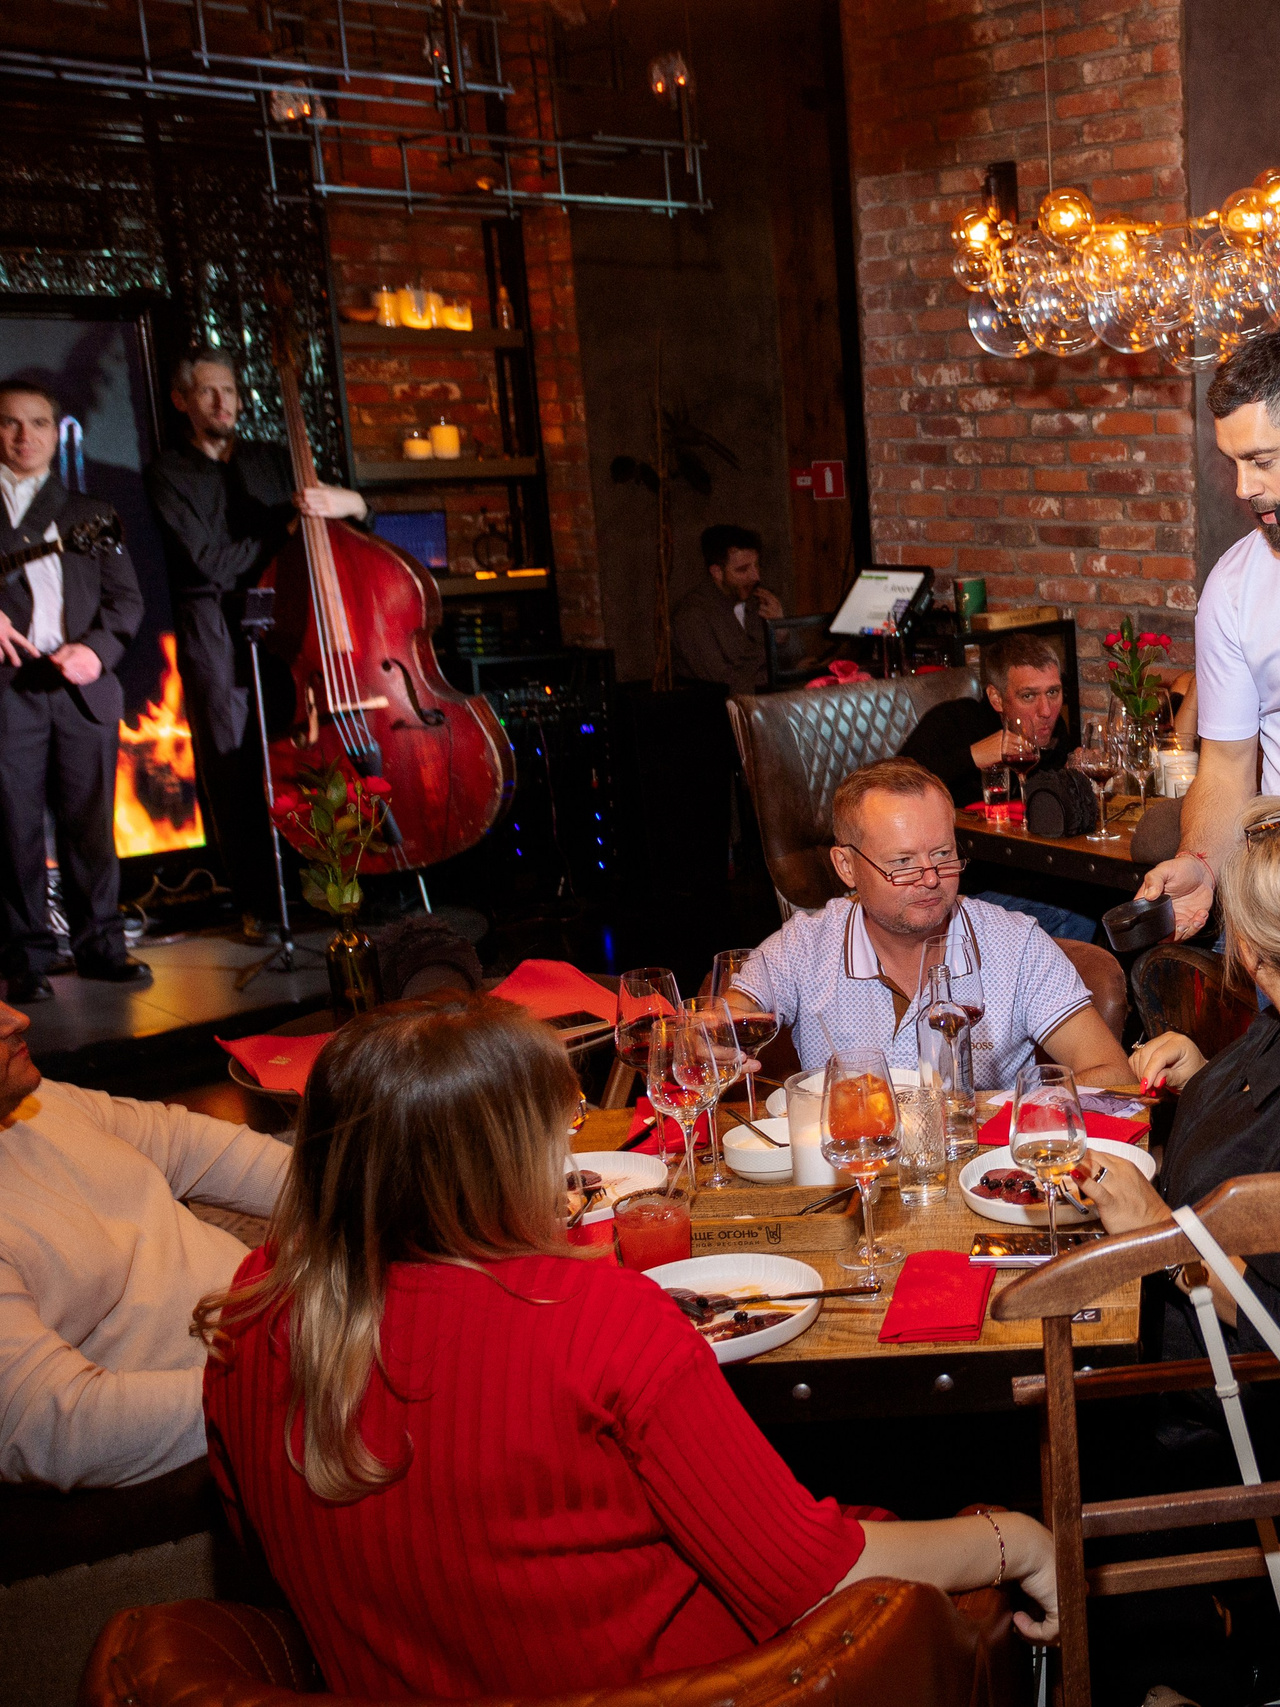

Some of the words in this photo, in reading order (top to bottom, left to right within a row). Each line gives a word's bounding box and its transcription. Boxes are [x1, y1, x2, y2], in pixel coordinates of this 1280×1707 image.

[971, 1041, 994, 1050] BOSS
[717, 1230, 759, 1239] ОГОНЬ
[1072, 1310, 1096, 1321] 27
